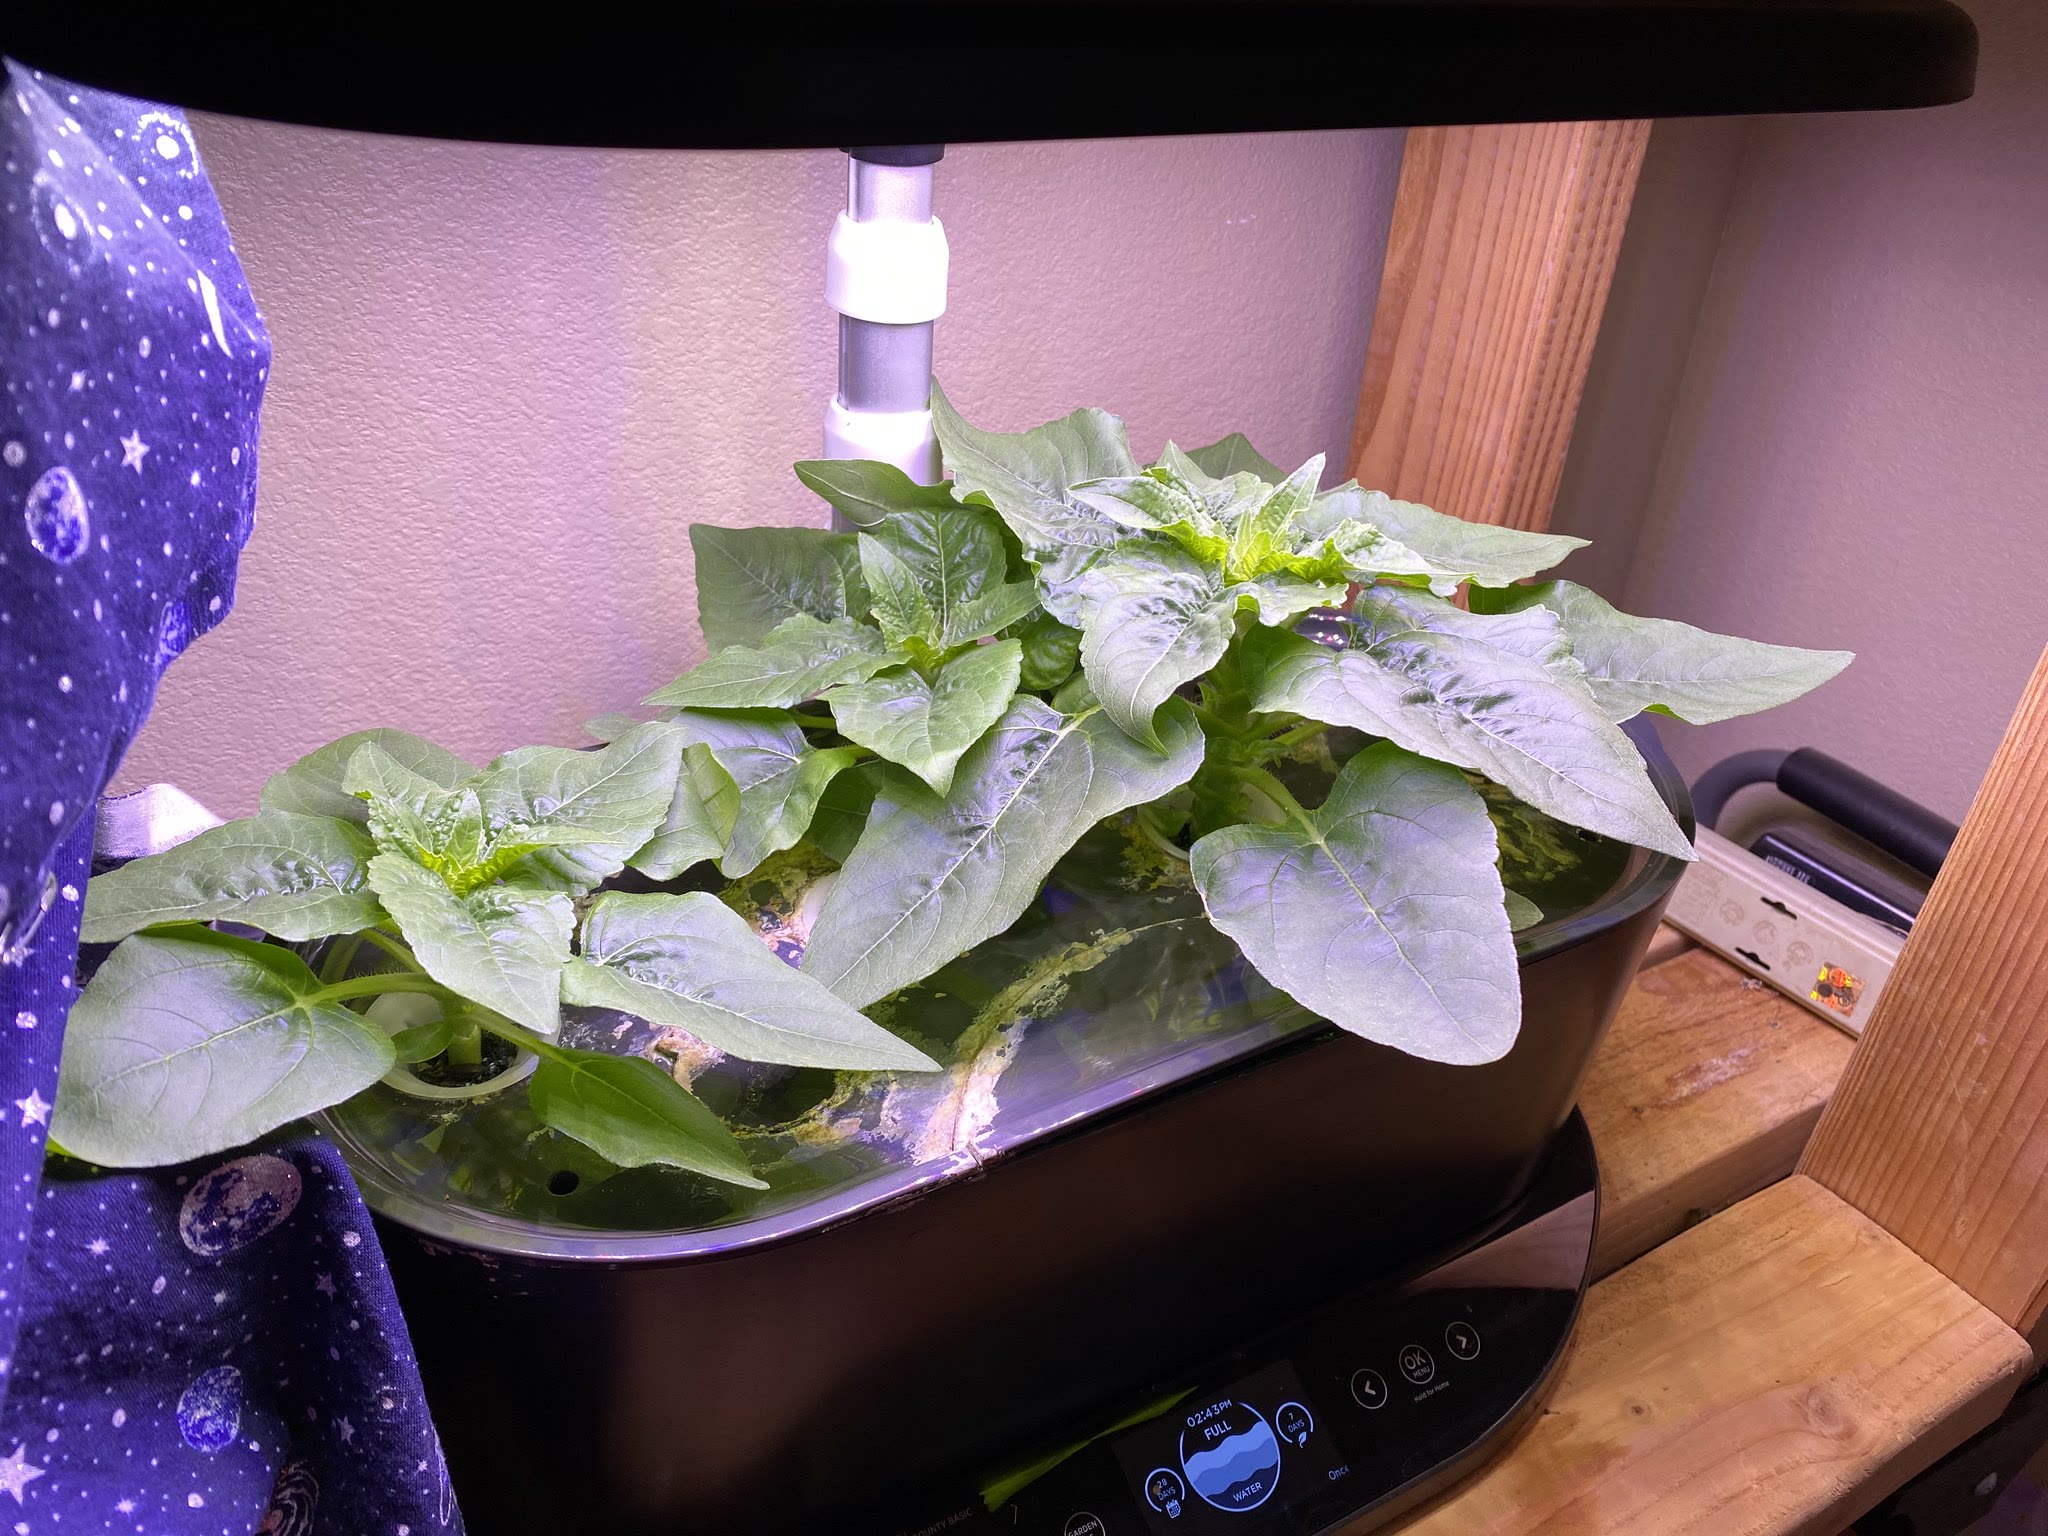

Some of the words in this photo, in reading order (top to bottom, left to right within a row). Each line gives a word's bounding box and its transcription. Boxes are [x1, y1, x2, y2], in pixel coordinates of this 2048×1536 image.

[1404, 1350, 1426, 1370] OK
[1412, 1365, 1431, 1379] MENU
[1413, 1391, 1427, 1403] Hold
[1426, 1388, 1434, 1397] for
[1433, 1381, 1450, 1392] Home
[1288, 1412, 1294, 1420] 7
[1203, 1420, 1232, 1441] FULL
[1287, 1419, 1305, 1433] DAYS
[1156, 1478, 1168, 1489] 28
[1232, 1481, 1263, 1502] WATER
[1158, 1486, 1176, 1501] DAYS
[947, 1507, 973, 1526] BASIC
